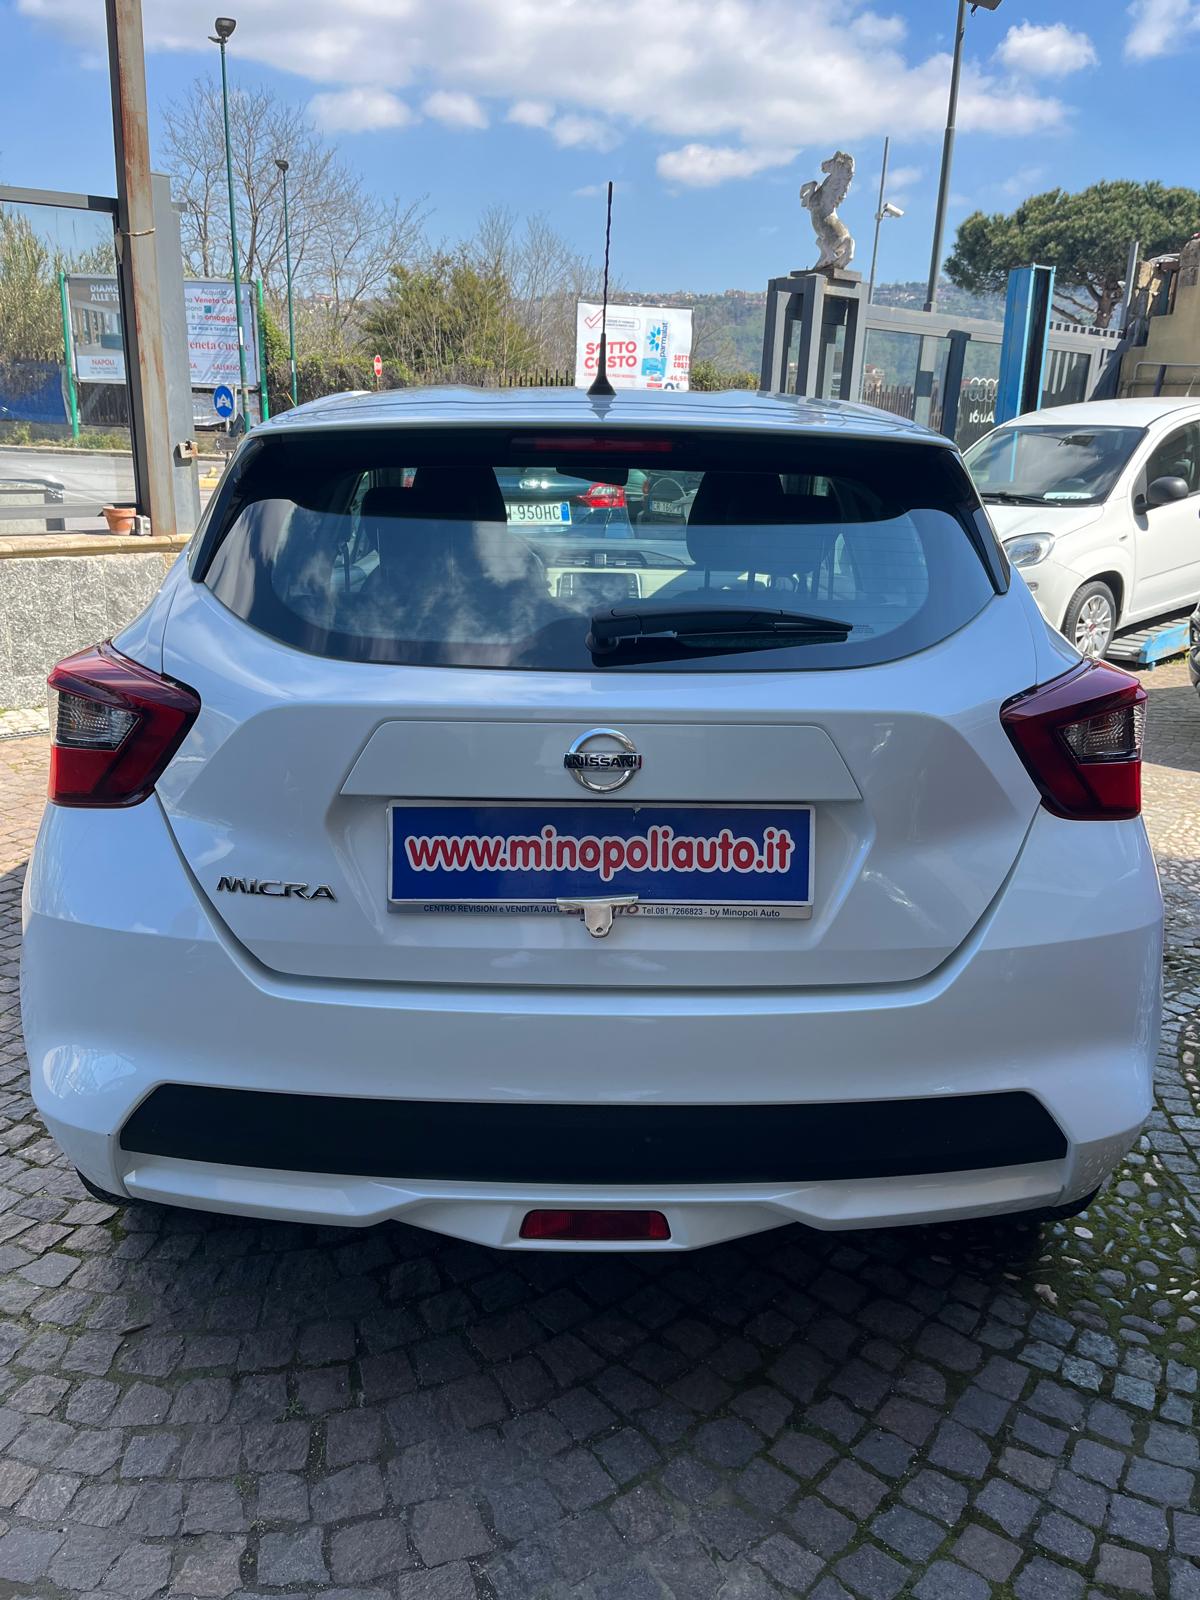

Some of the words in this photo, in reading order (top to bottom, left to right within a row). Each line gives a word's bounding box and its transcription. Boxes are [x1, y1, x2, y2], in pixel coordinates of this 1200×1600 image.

[90, 293, 110, 302] ALLE
[188, 341, 216, 350] eneta
[218, 341, 250, 352] Cucie
[660, 322, 668, 358] parmalat
[91, 359, 115, 367] NAPOLI
[518, 504, 560, 520] 950HC
[572, 756, 636, 768] NISSAN
[405, 826, 795, 881] www.minopoliauto.it
[216, 875, 337, 902] MICRA
[423, 904, 457, 912] CENTRO
[457, 904, 498, 913] REVISIONI
[505, 905, 539, 913] VENDITA
[710, 908, 720, 918] by
[722, 908, 758, 918] Minopoli
[760, 909, 780, 917] Auto
